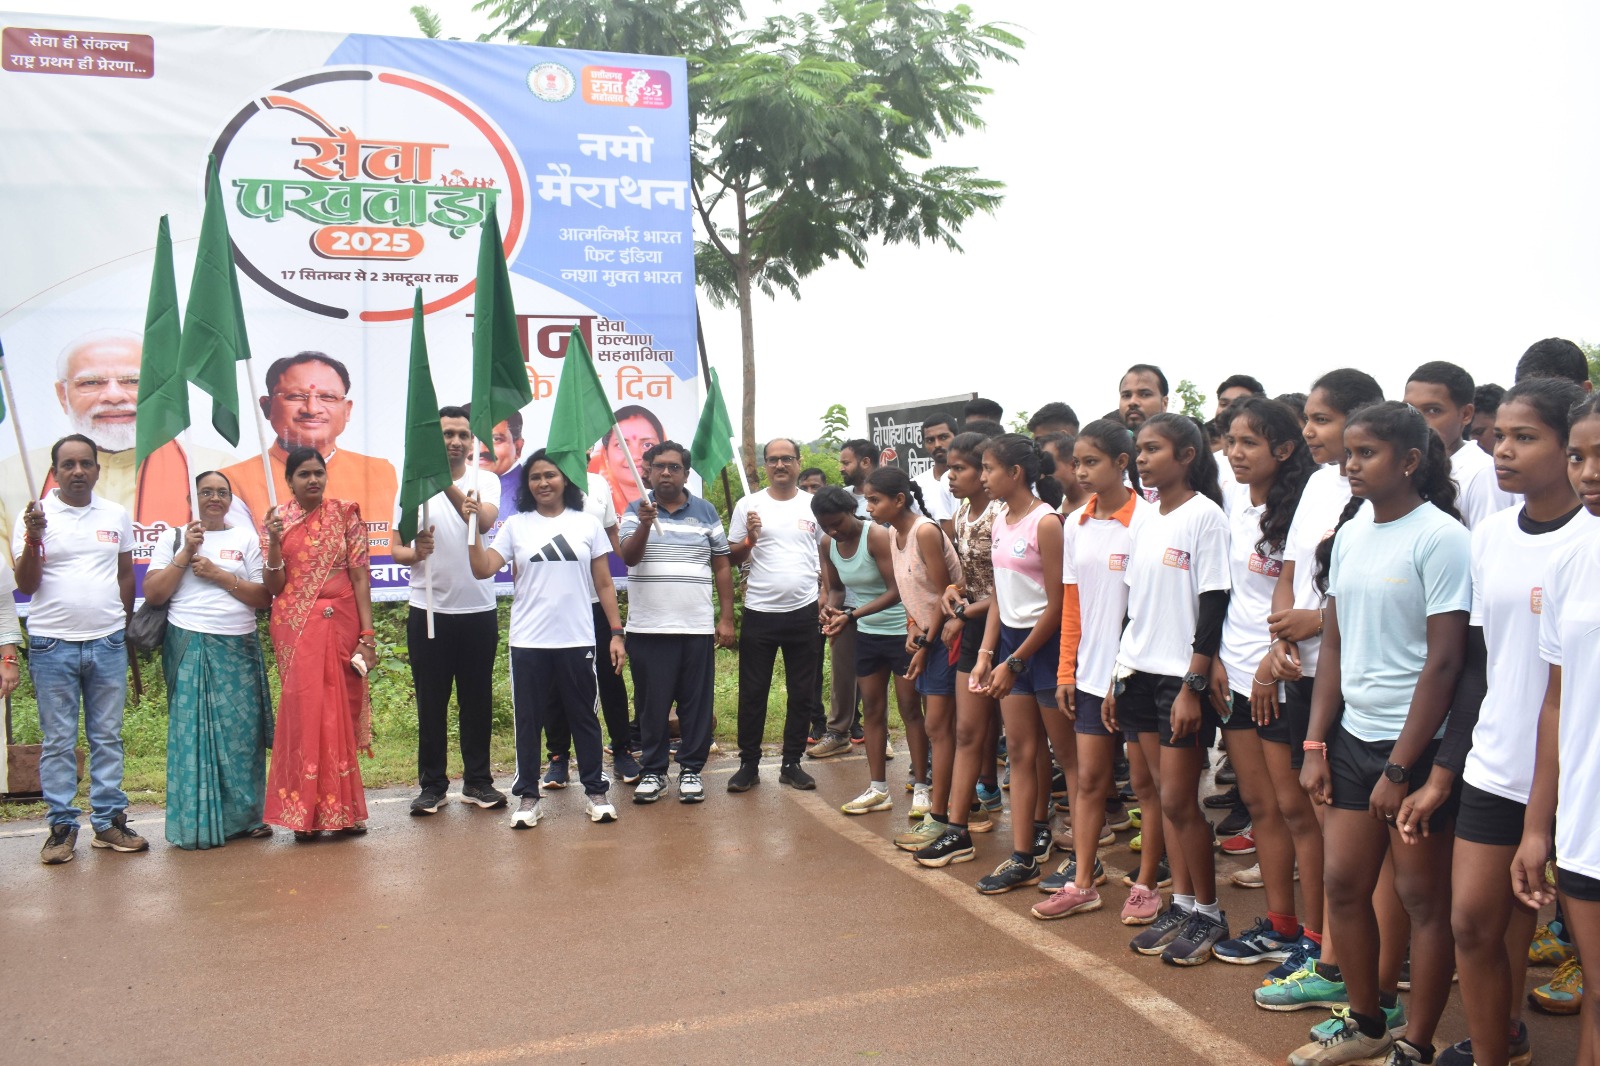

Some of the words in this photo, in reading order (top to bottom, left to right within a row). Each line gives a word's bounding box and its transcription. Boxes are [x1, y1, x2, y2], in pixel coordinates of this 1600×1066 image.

[28, 33, 59, 48] सेवा
[62, 35, 79, 49] ही
[81, 37, 130, 52] संकल्प
[10, 54, 36, 69] राष्ट्र
[39, 56, 74, 69] प्रथम
[77, 56, 94, 70] ही
[590, 80, 623, 94] रजत
[643, 84, 662, 97] 25
[590, 92, 624, 103] महोत्सव
[577, 125, 654, 163] नमो
[291, 126, 449, 183] सेवा
[536, 163, 688, 211] मैराथन
[232, 179, 502, 239] पखवाड़ा
[330, 231, 411, 252] 2025
[558, 225, 640, 243] आत्मनिर्भर
[643, 230, 682, 244] भारत
[584, 245, 616, 263] फिट
[619, 247, 663, 264] इंडिया
[281, 270, 296, 280] 17
[299, 267, 351, 281] सितम्बर
[354, 269, 367, 281] से
[370, 272, 378, 282] 2
[382, 272, 431, 287] अक्टूबर
[434, 274, 459, 284] तक
[560, 269, 598, 283] नशा
[601, 270, 640, 287] मुक्त
[643, 271, 682, 284] भारत
[596, 317, 625, 332] सेवा
[597, 334, 653, 346] कल्याण
[598, 347, 674, 362] सहभागिता
[615, 365, 674, 400] दिन
